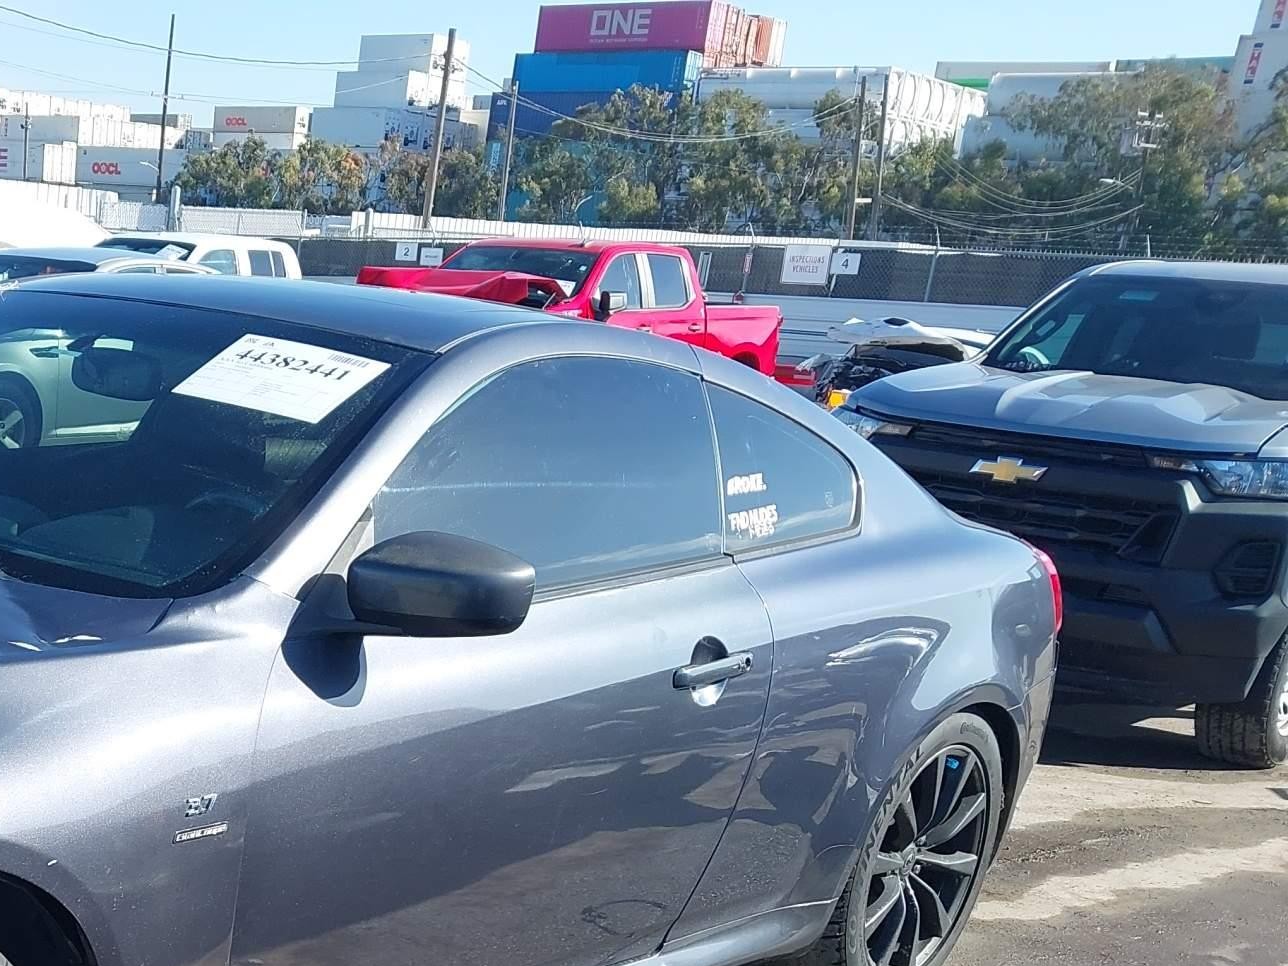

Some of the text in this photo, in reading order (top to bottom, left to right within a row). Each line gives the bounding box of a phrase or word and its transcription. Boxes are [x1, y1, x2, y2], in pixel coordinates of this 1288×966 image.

[589, 8, 653, 36] ONE
[225, 116, 248, 127] OOCL
[92, 161, 121, 176] OOCL
[402, 246, 411, 257] 2
[792, 264, 819, 274] VEHICLES
[840, 258, 850, 270] 4
[234, 348, 353, 381] 44382441
